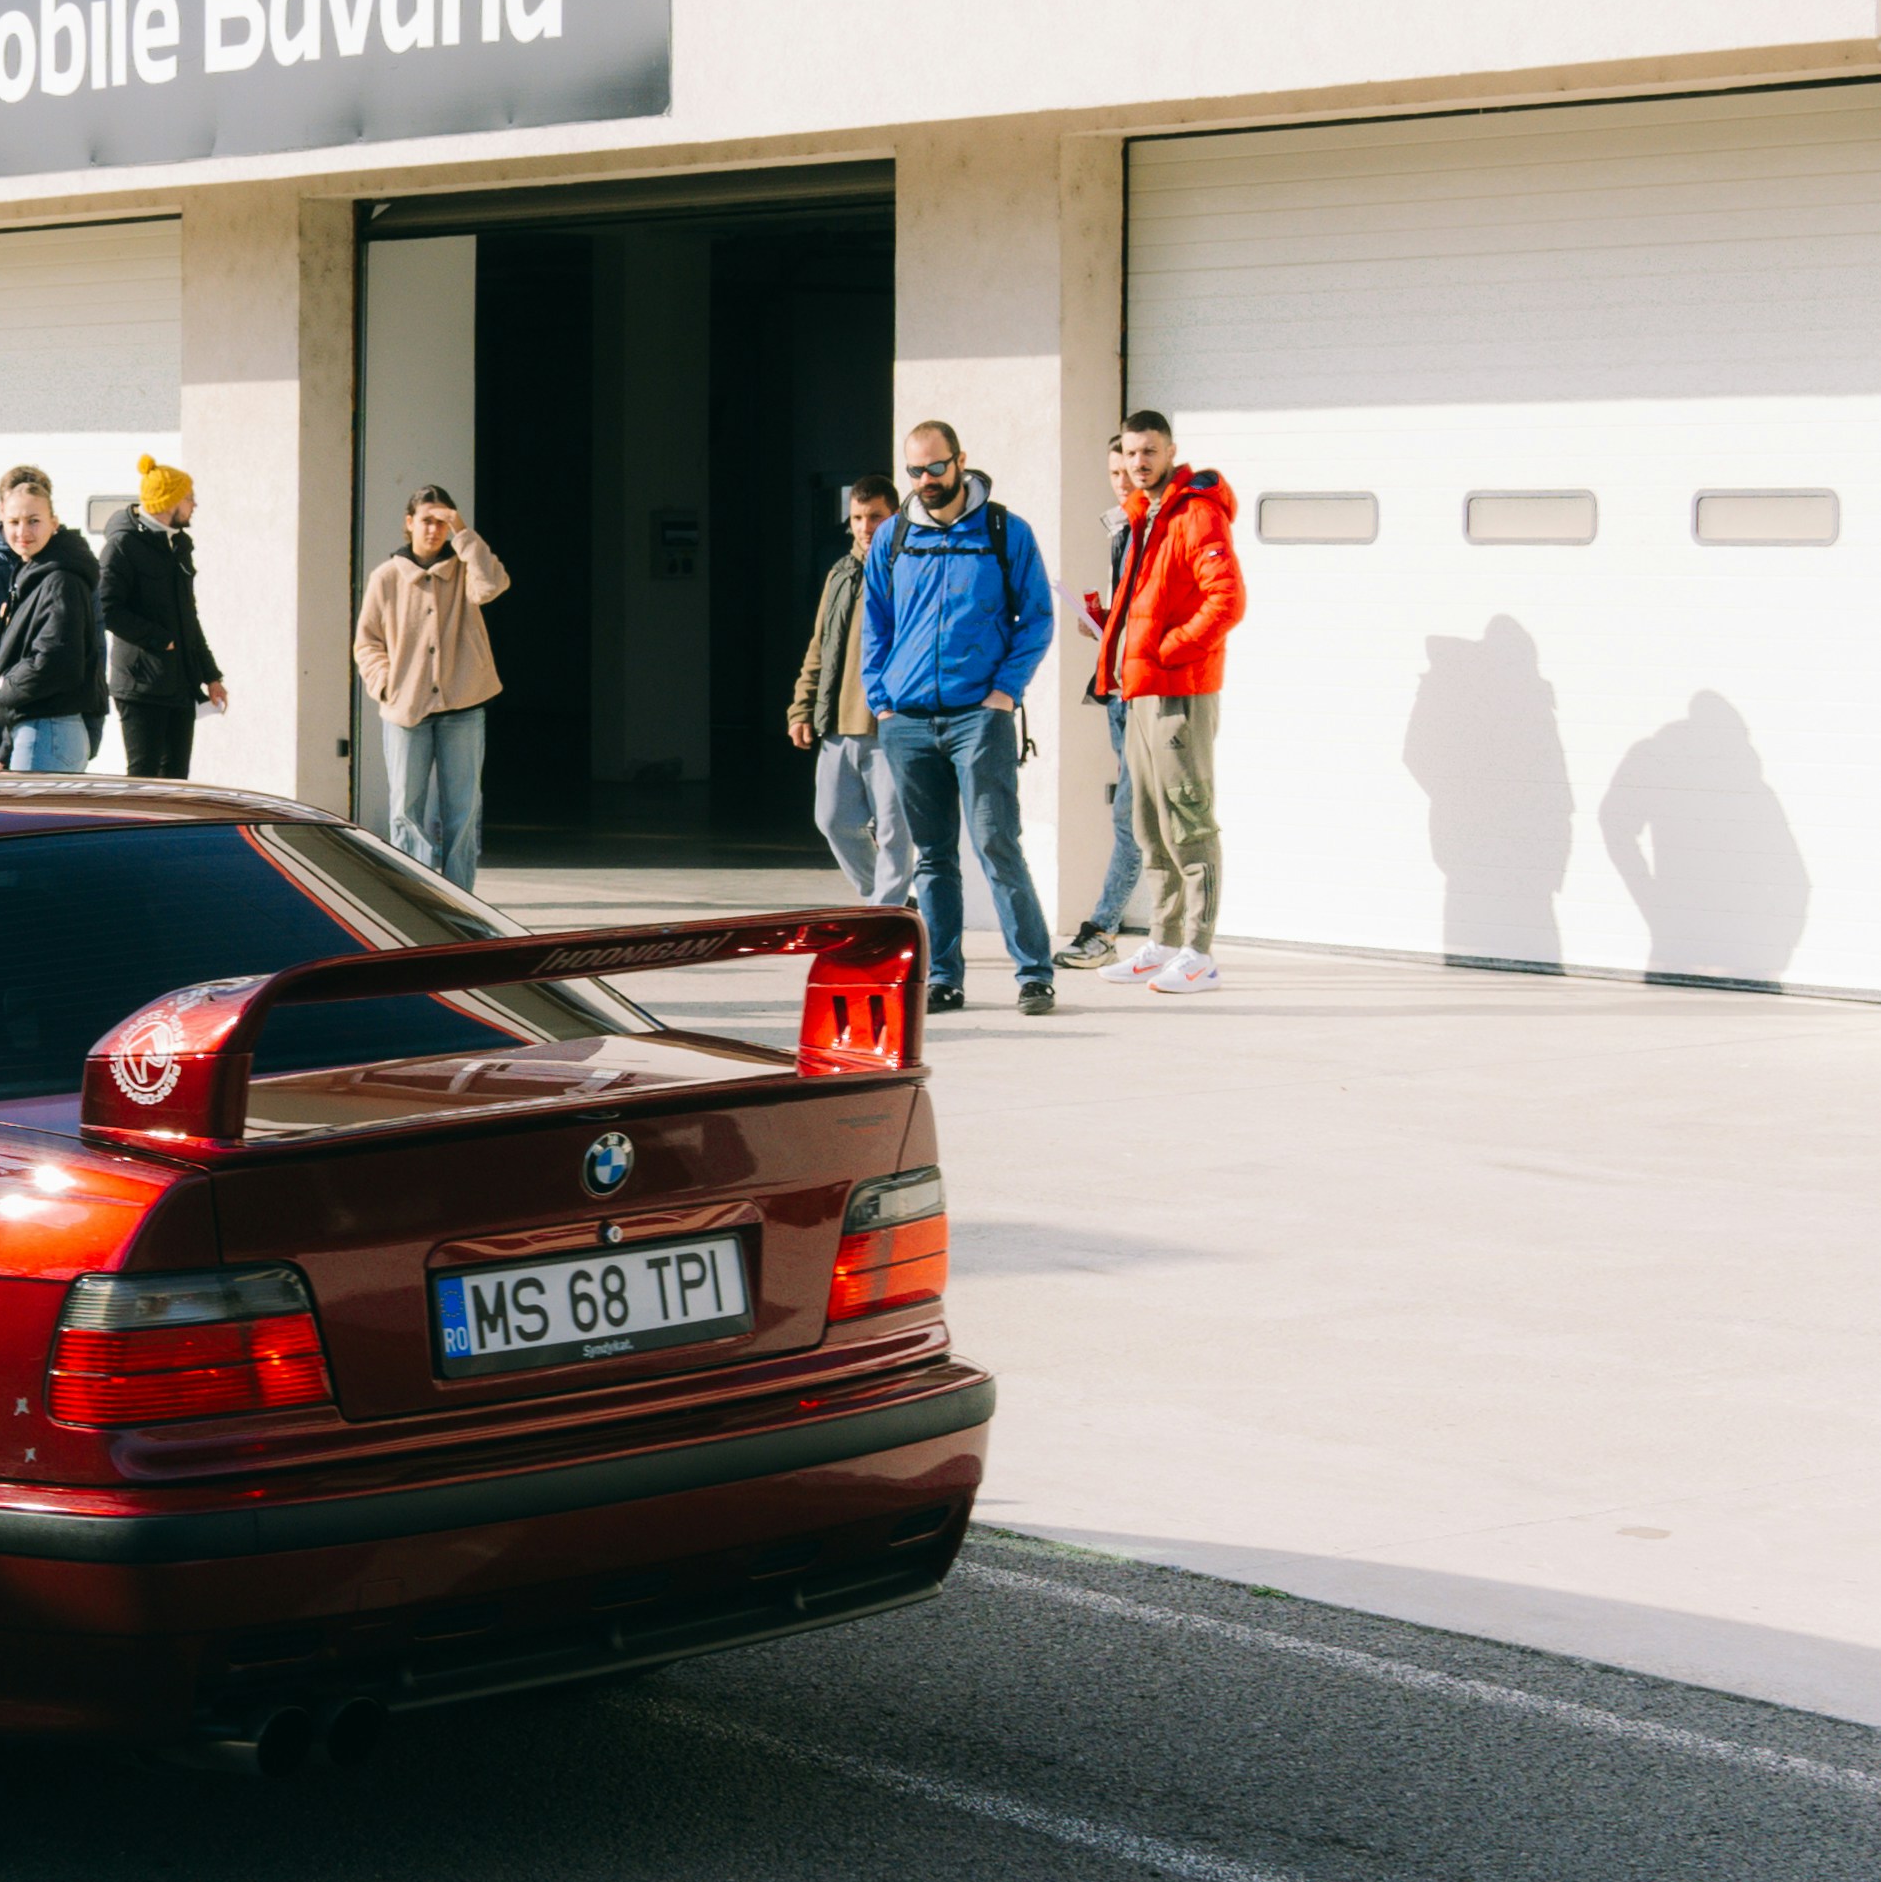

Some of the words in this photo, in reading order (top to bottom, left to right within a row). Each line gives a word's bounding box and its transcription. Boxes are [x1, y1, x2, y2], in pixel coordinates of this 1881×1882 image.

[471, 1276, 549, 1350] MS
[569, 1264, 629, 1332] 68
[646, 1250, 724, 1321] TPI
[445, 1326, 469, 1353] RO
